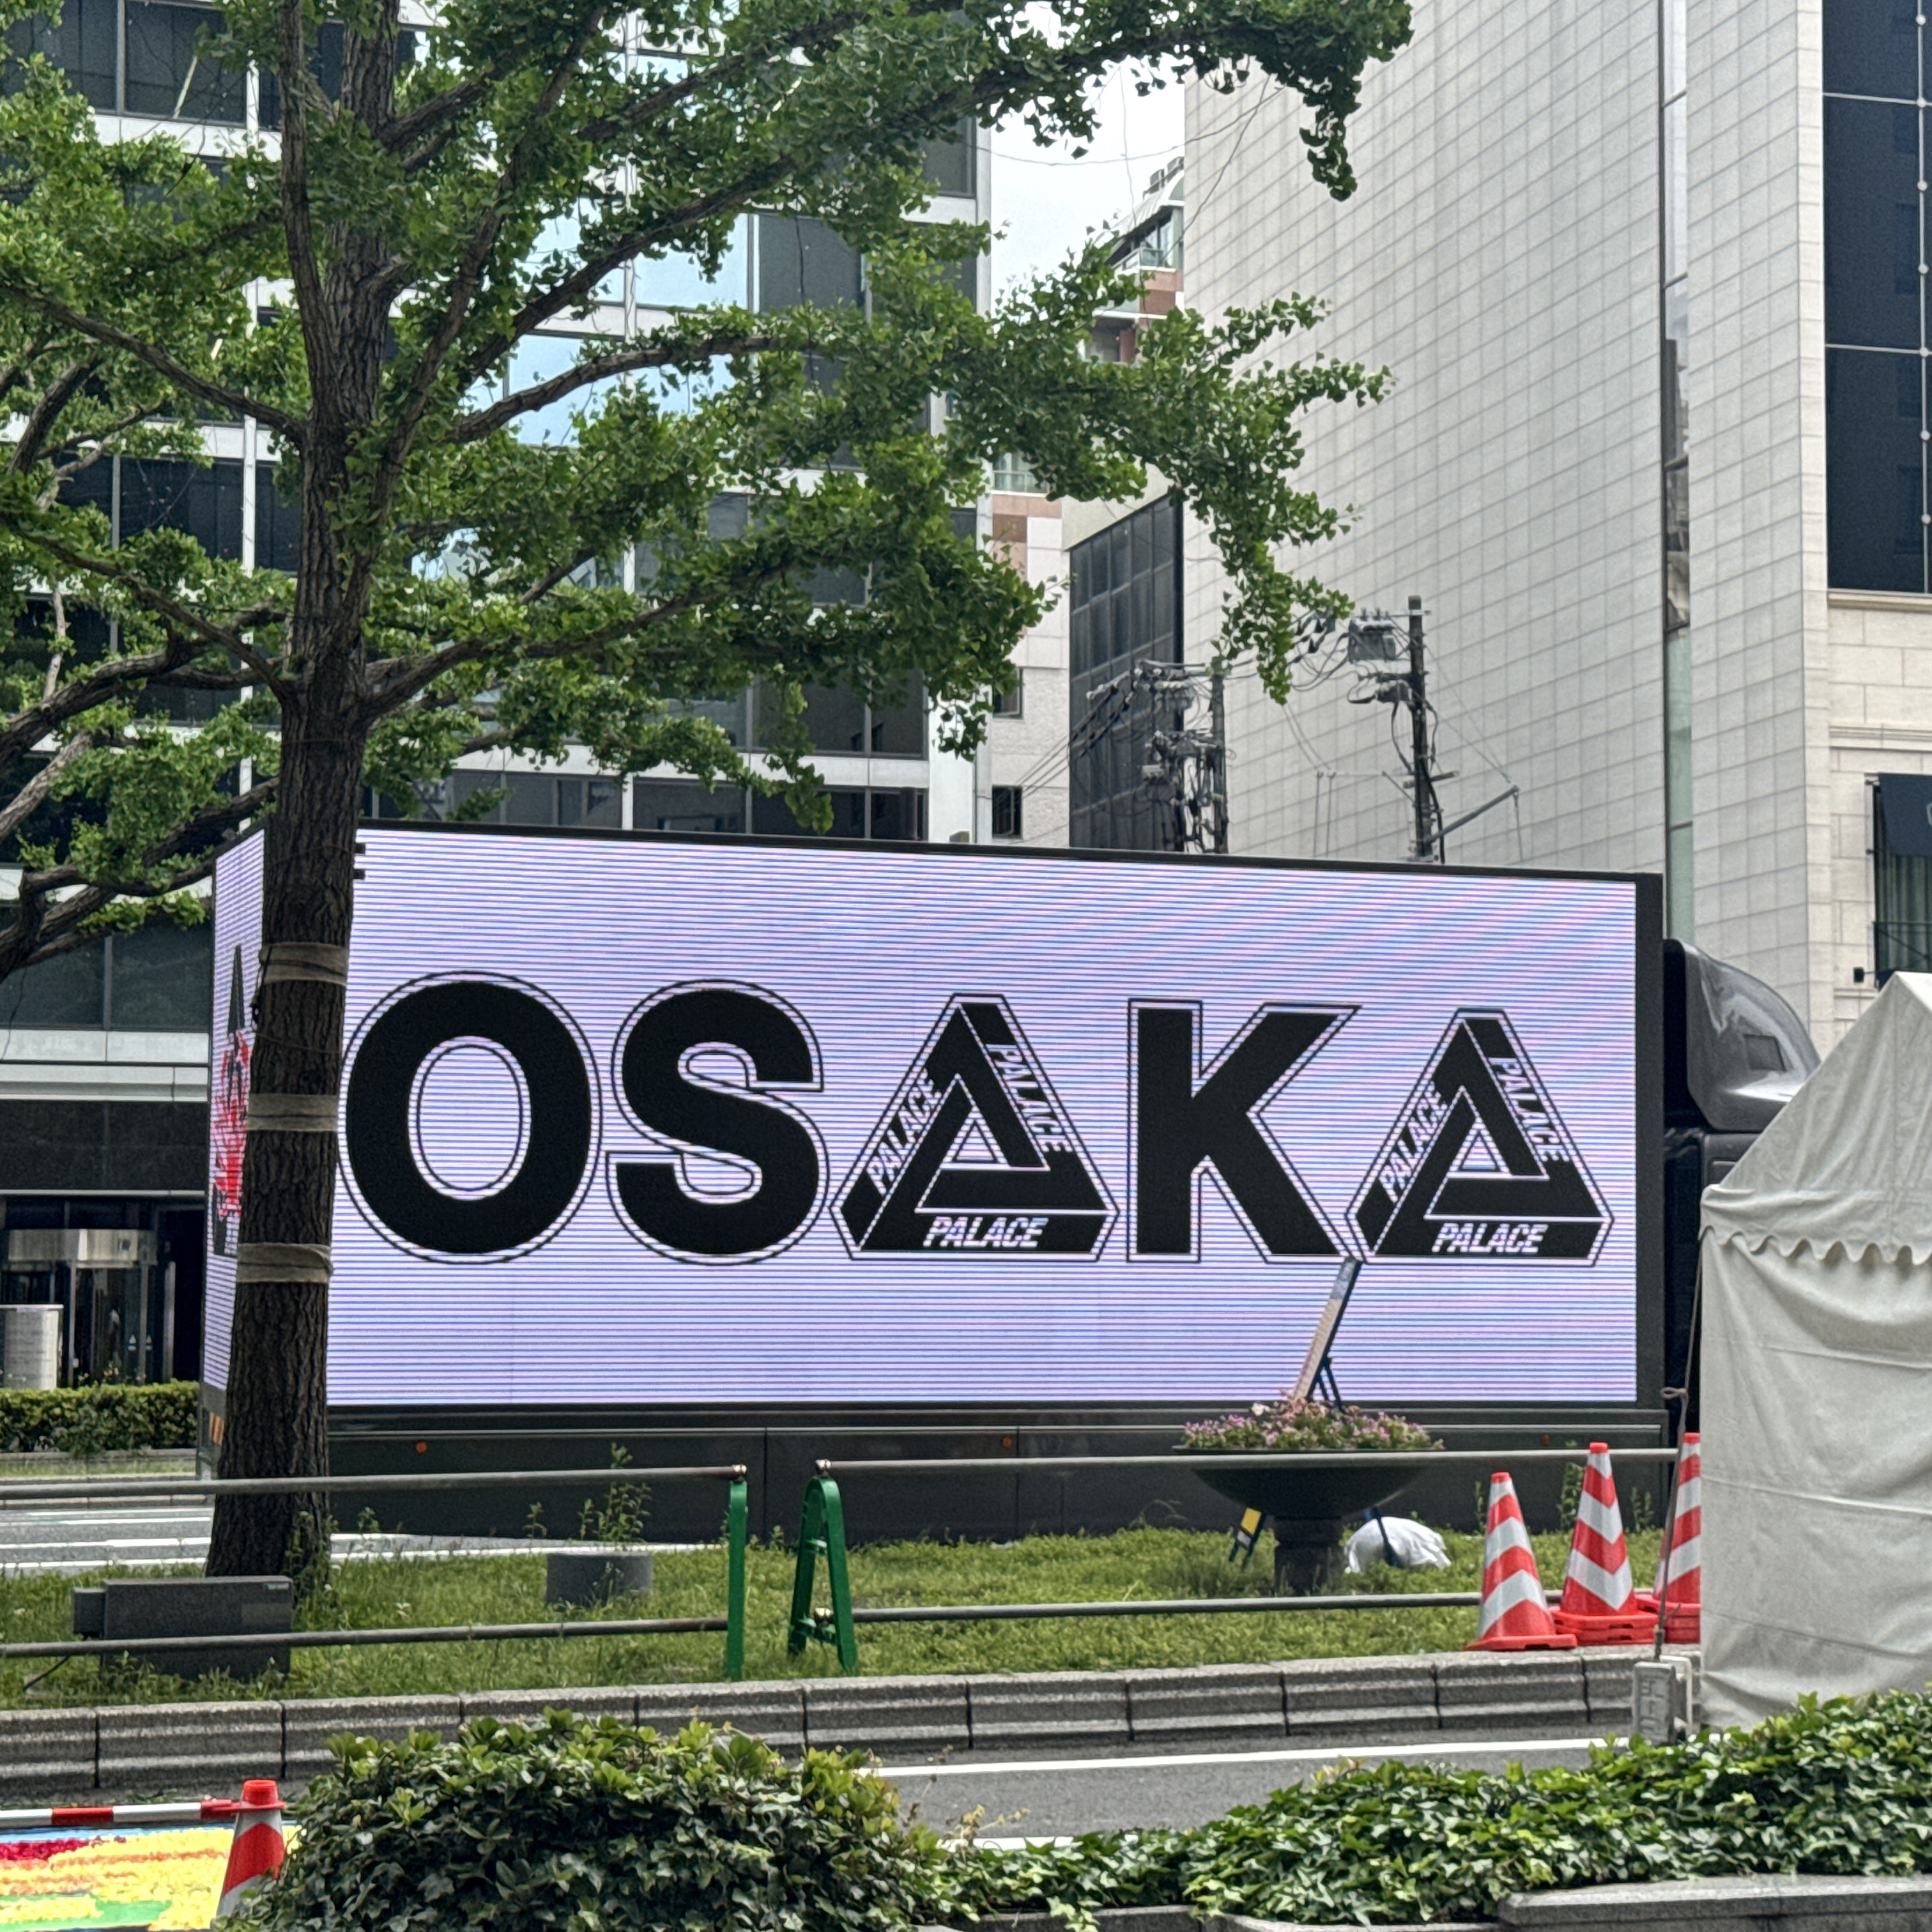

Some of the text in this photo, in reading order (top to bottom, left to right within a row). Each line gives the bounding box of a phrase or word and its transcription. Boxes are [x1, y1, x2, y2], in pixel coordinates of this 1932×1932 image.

[337, 971, 1614, 1266] OSAKA
[866, 1068, 942, 1196] PALACE
[985, 1043, 1074, 1152] PALACE
[1377, 1080, 1448, 1204] PALACE
[1487, 1057, 1570, 1162] PALACE
[923, 1216, 1049, 1248] PALACE
[1431, 1222, 1549, 1253] PALACE
